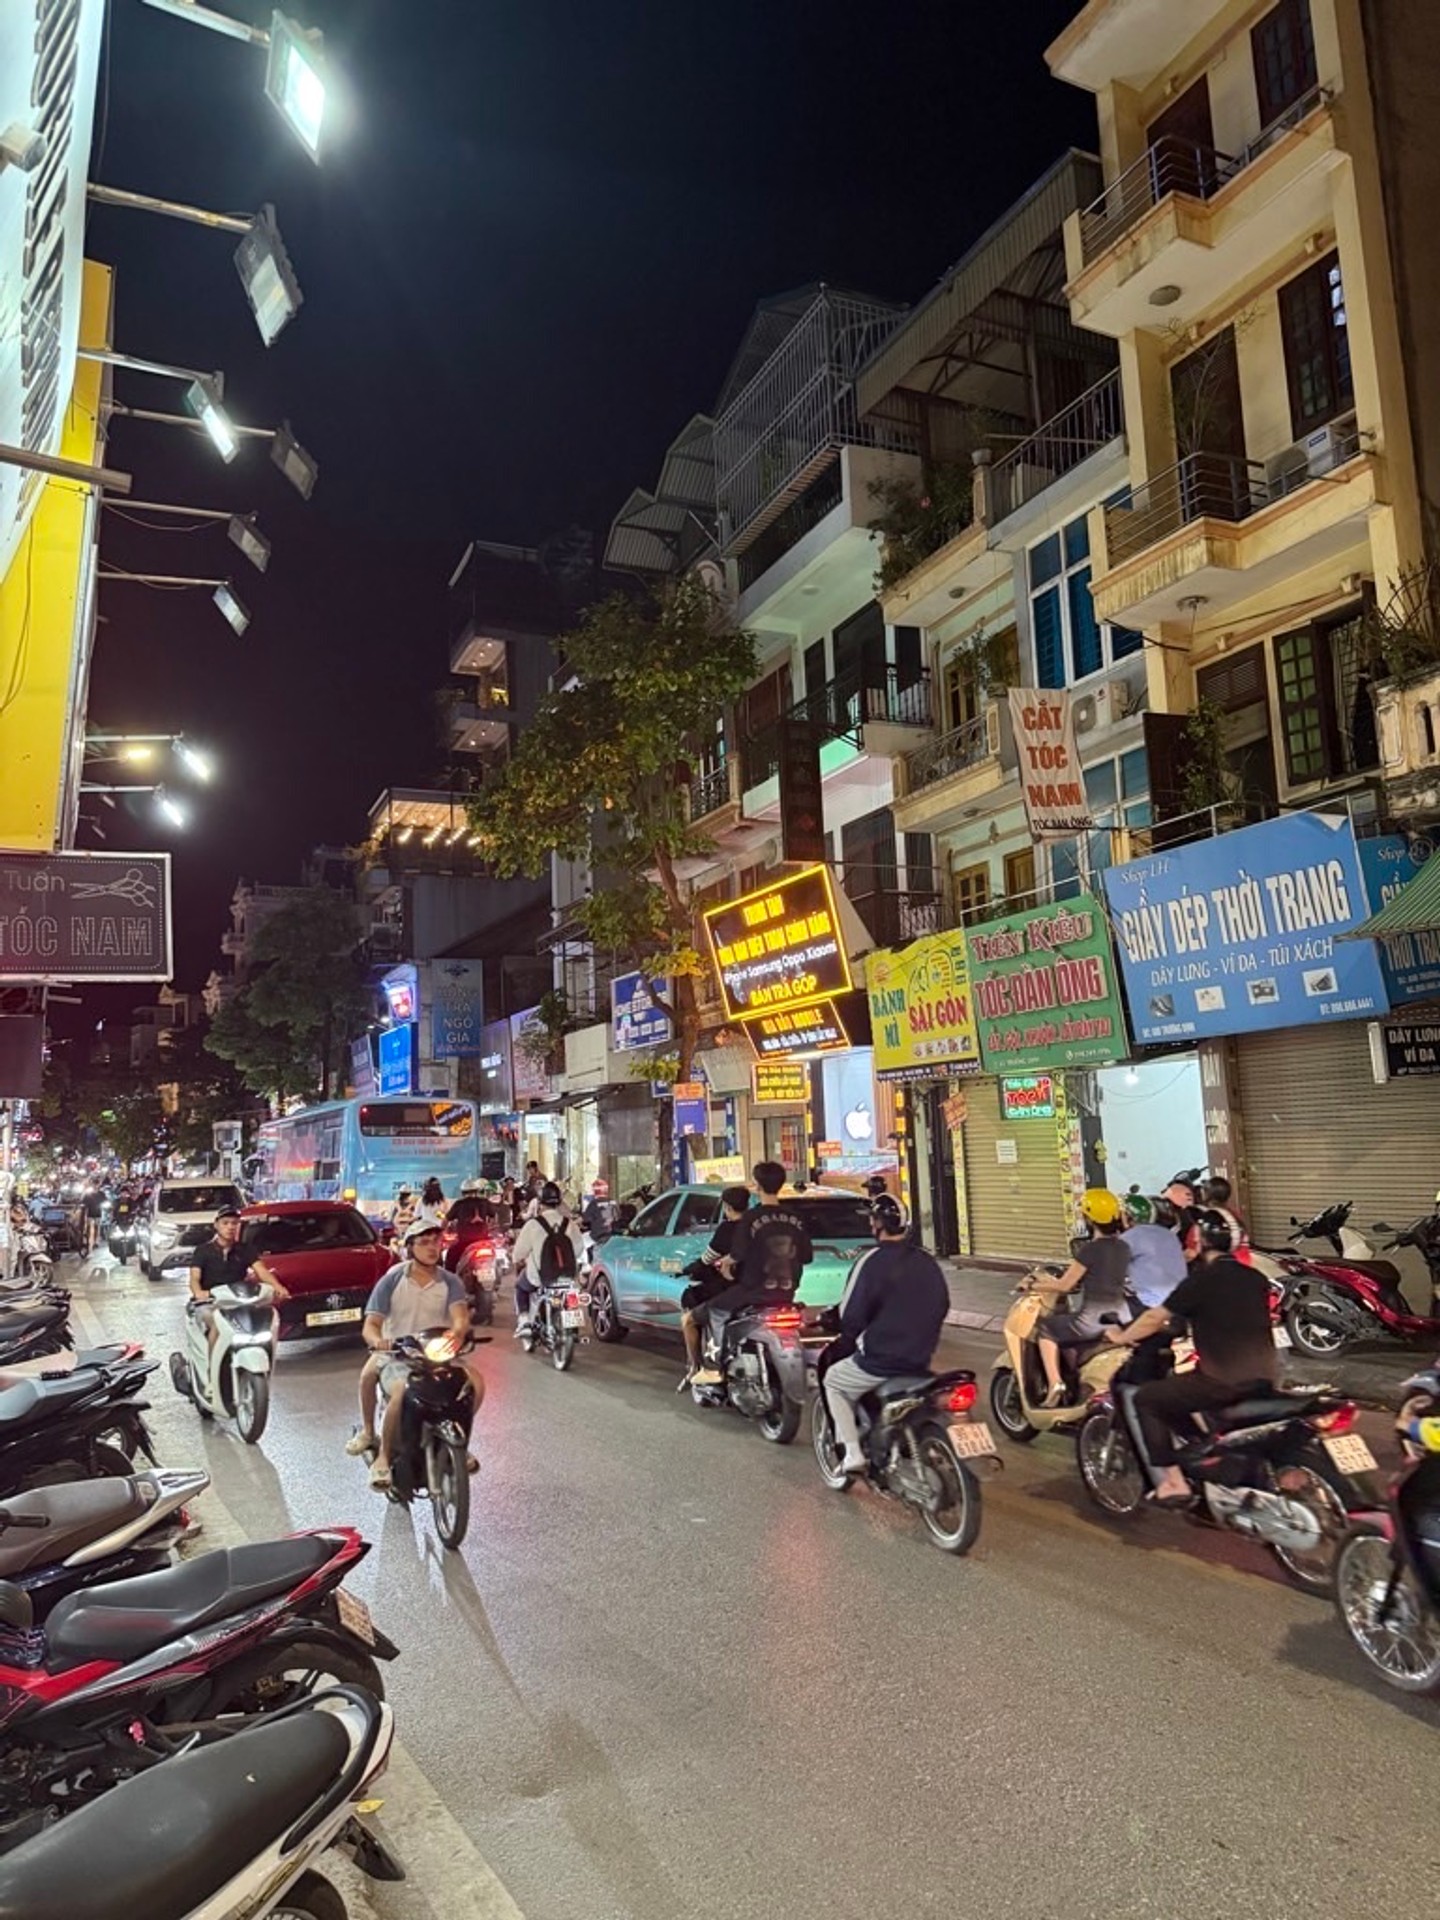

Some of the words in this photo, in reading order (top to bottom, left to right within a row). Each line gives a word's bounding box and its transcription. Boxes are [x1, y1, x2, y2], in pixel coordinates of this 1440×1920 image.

[1026, 741, 1068, 770] TÓC
[1027, 782, 1082, 808] NAM
[3, 865, 65, 892] Tuấn
[1168, 885, 1209, 955] DÉP
[1211, 868, 1268, 945] THỜI
[1265, 859, 1352, 935] TRANG
[71, 916, 153, 956] NAM
[747, 959, 784, 978] Samsung
[781, 952, 806, 969] Oppo
[805, 938, 838, 961] Xiaomi
[1177, 961, 1211, 982] LƯNG
[1267, 943, 1290, 967] TÚI
[1293, 936, 1333, 962] XÁCH
[1055, 953, 1107, 1007] ÔNG
[871, 987, 907, 1018] BÁNH
[446, 1031, 470, 1043] GIA
